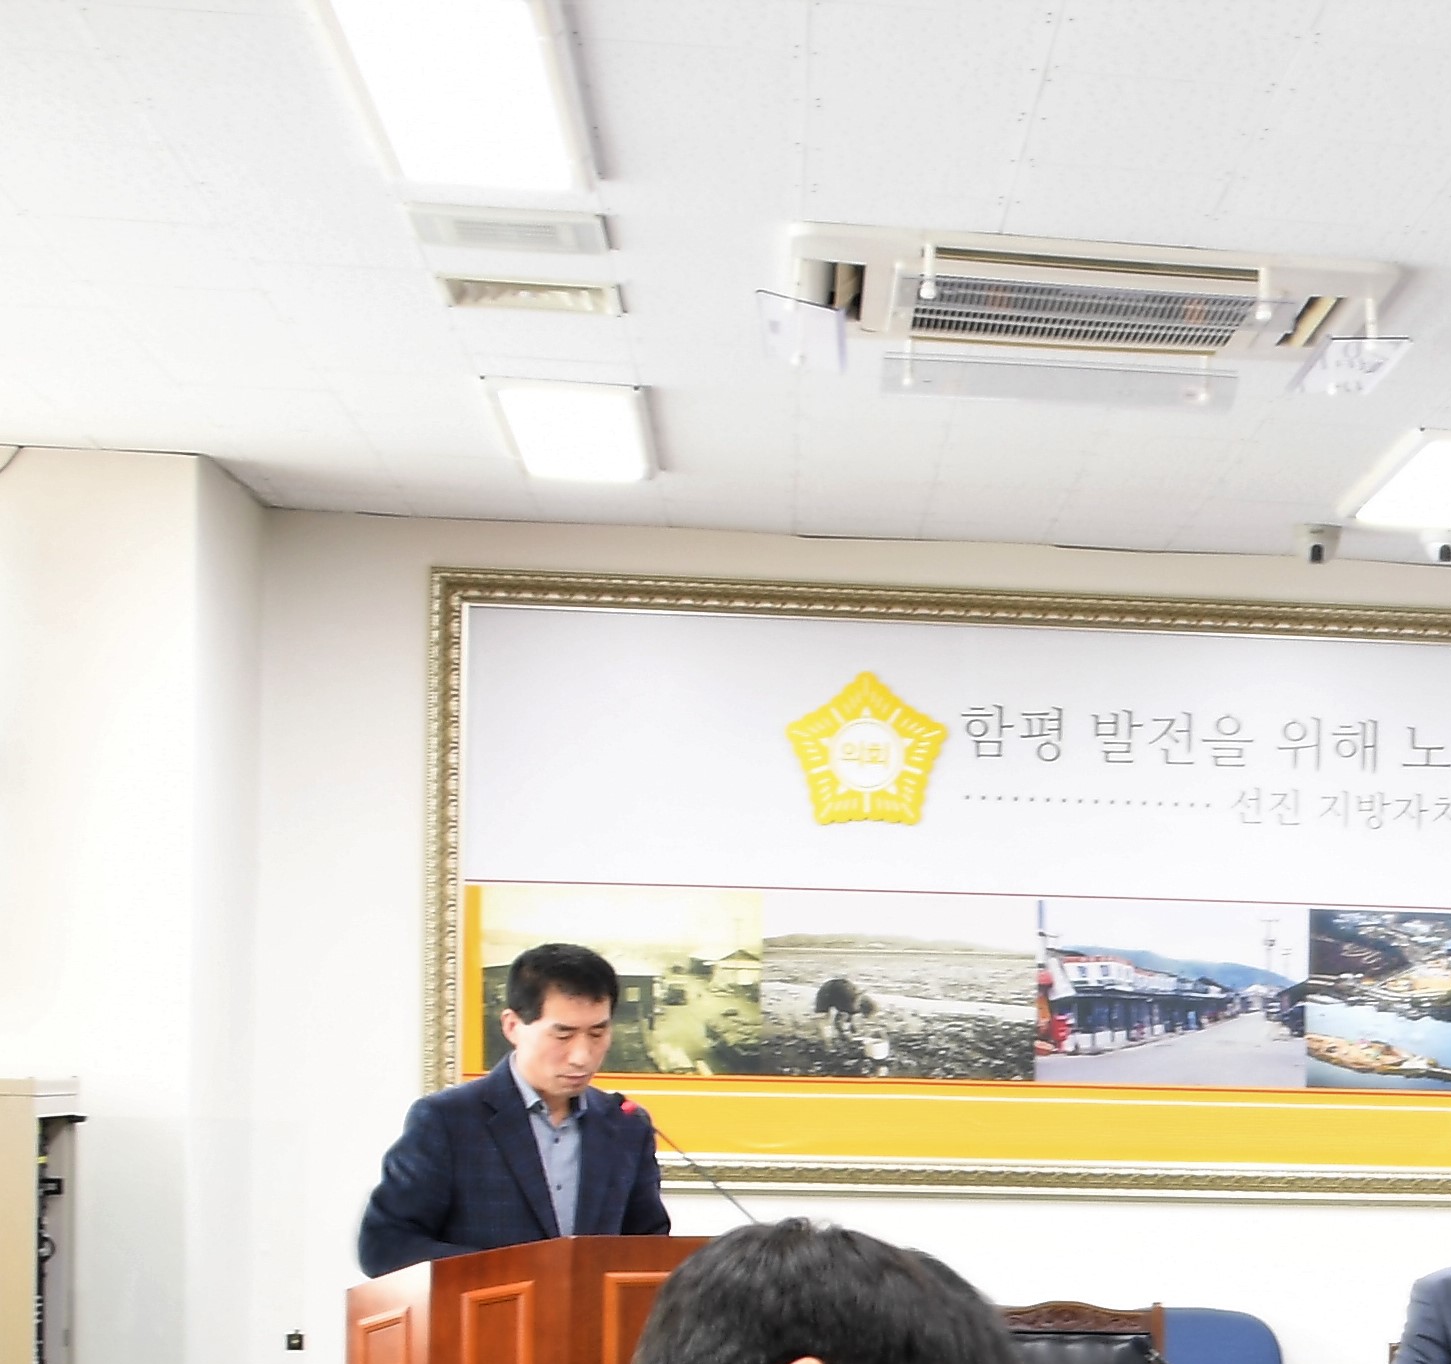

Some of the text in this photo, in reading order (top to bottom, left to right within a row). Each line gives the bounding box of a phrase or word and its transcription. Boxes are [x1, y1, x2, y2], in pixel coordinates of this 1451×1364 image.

[961, 704, 1064, 763] 함평
[1091, 709, 1253, 768] 발전을
[1277, 716, 1379, 773] 위해
[1231, 787, 1301, 828] 선진
